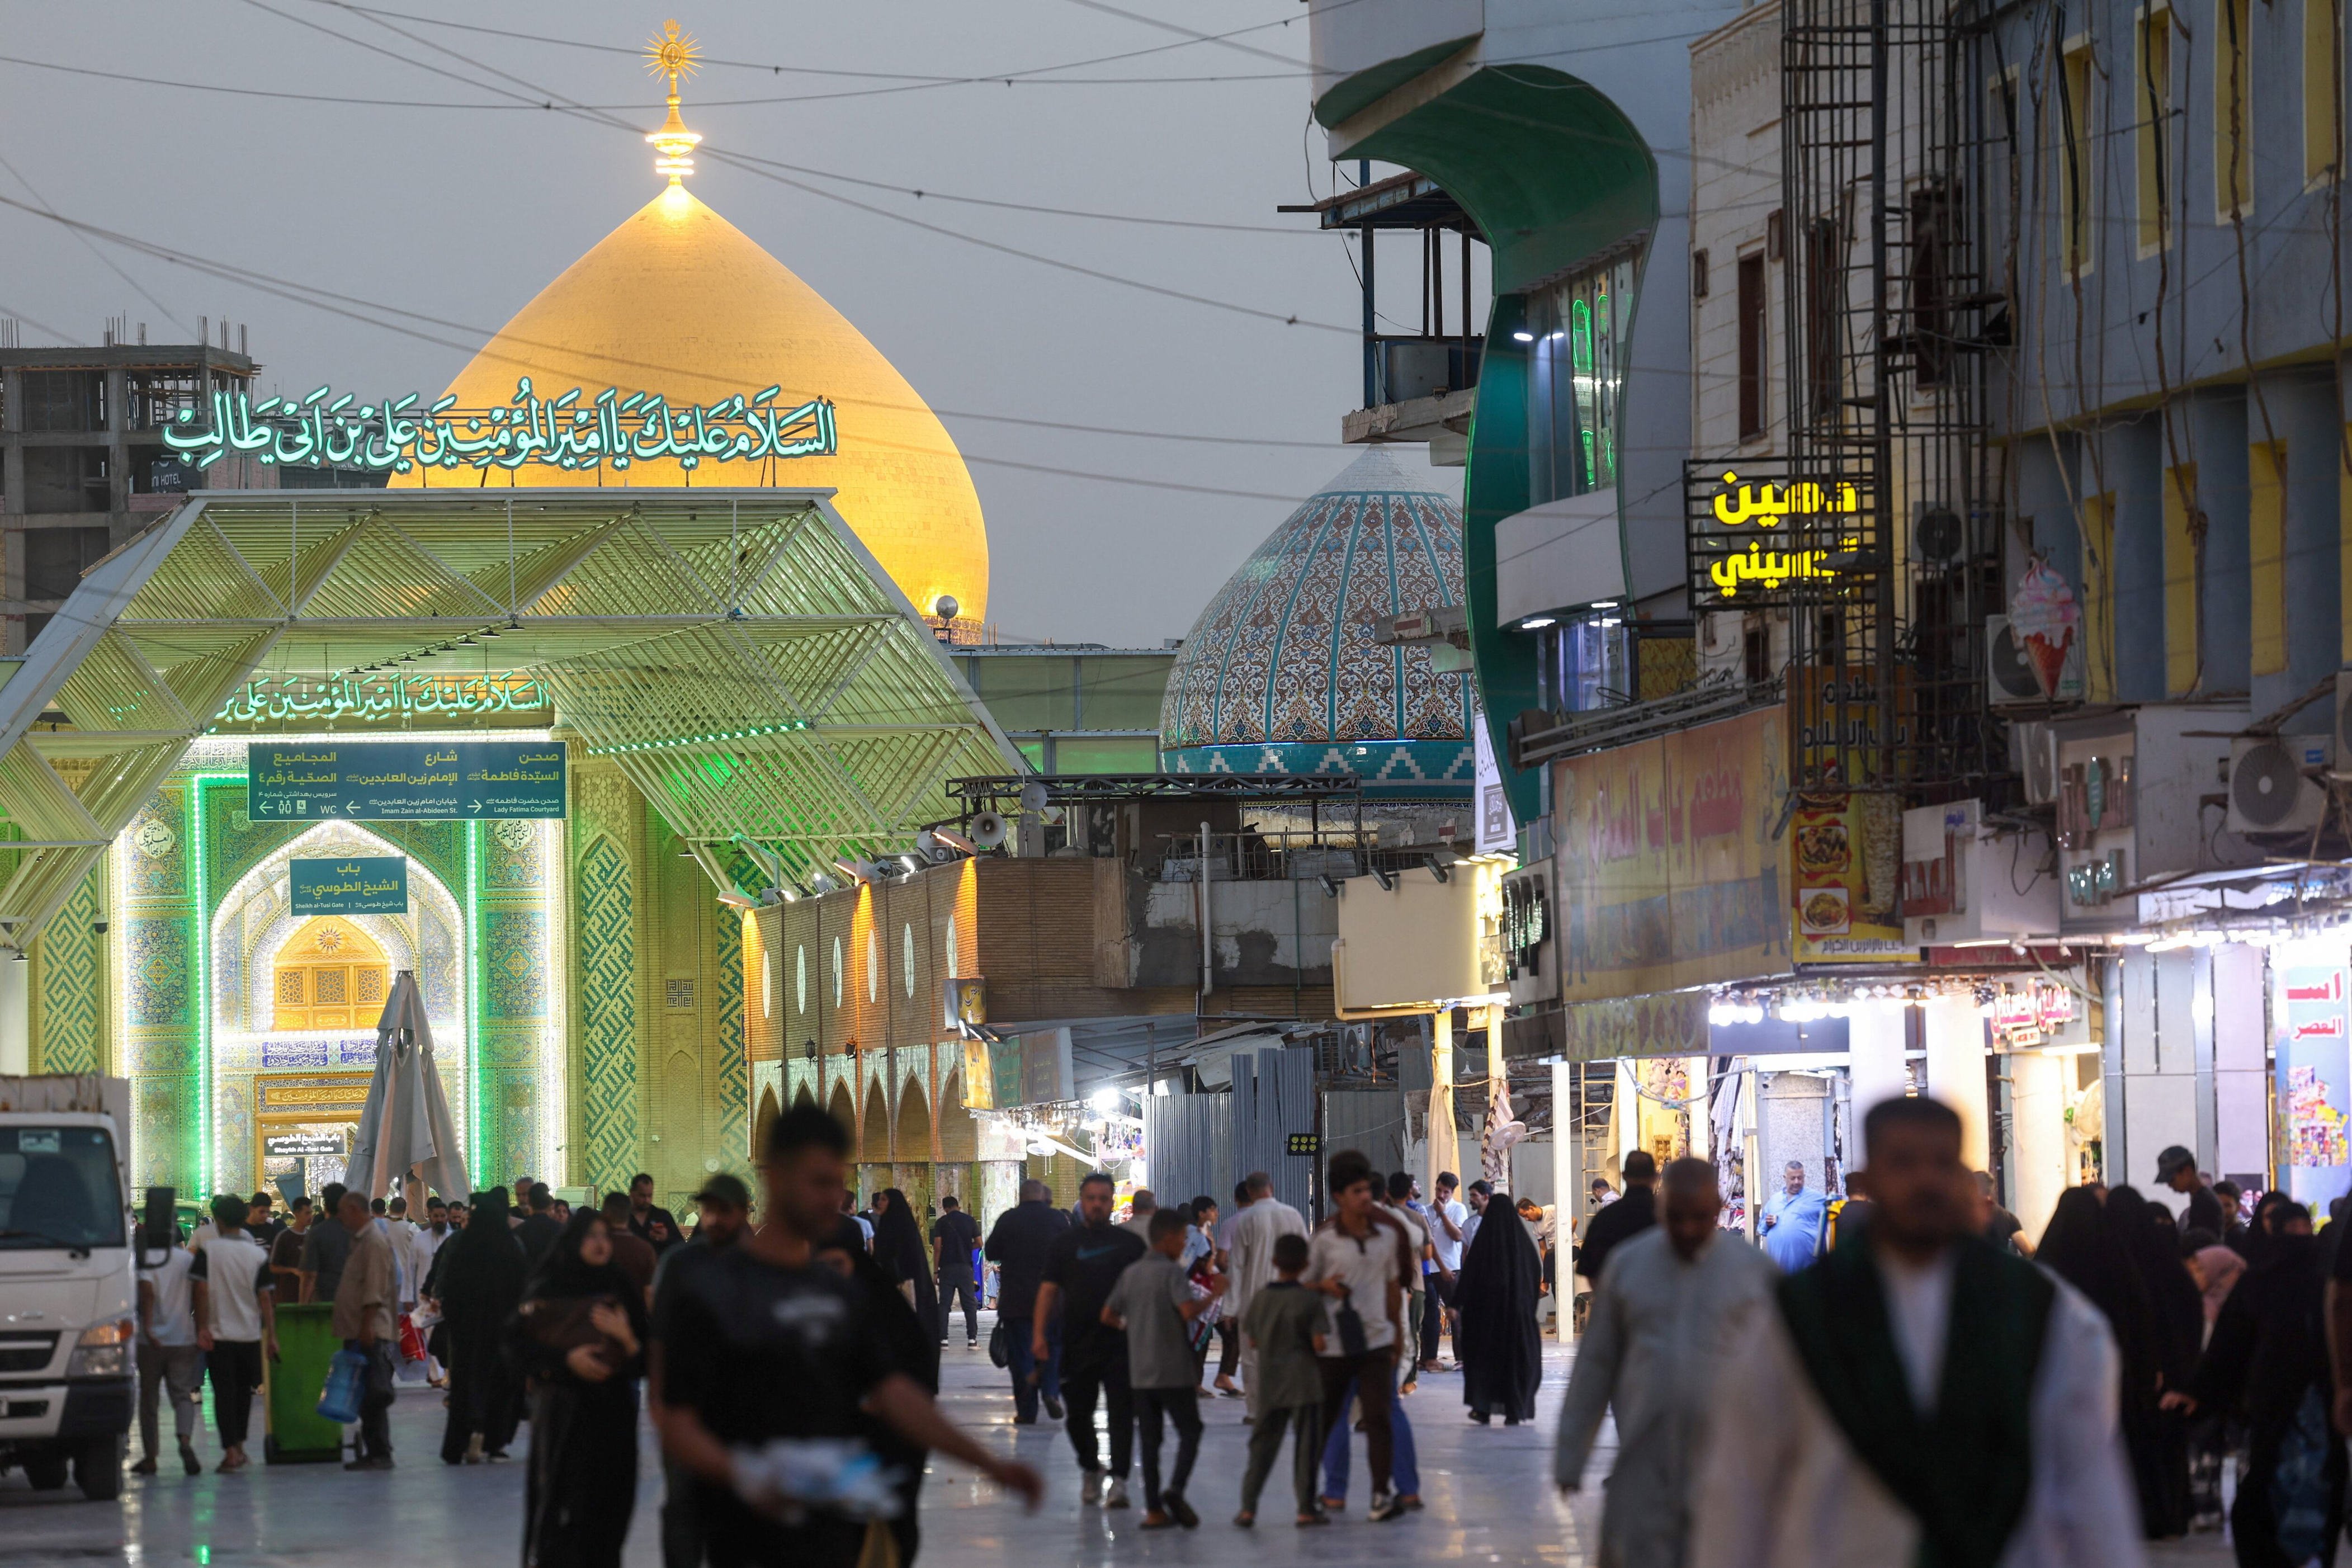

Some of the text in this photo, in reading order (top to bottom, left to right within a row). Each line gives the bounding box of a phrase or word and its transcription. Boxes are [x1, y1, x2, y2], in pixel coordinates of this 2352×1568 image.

[160, 473, 181, 485] HOTEL
[273, 752, 337, 767] المجاميع
[424, 749, 458, 767] شارع
[519, 753, 559, 764] صحن
[259, 772, 266, 783] ٤
[266, 770, 286, 786] رقم
[359, 773, 406, 785] العابدين
[407, 773, 427, 785] زين
[428, 772, 458, 786] الإمام
[481, 768, 520, 781] فاطمة
[420, 798, 435, 806] امام
[320, 805, 337, 814] WC
[337, 863, 361, 876] باب
[312, 881, 361, 900] الطوسي
[363, 879, 399, 896] الشيخ
[267, 1132, 341, 1147] باب الشيخ الطوسي
